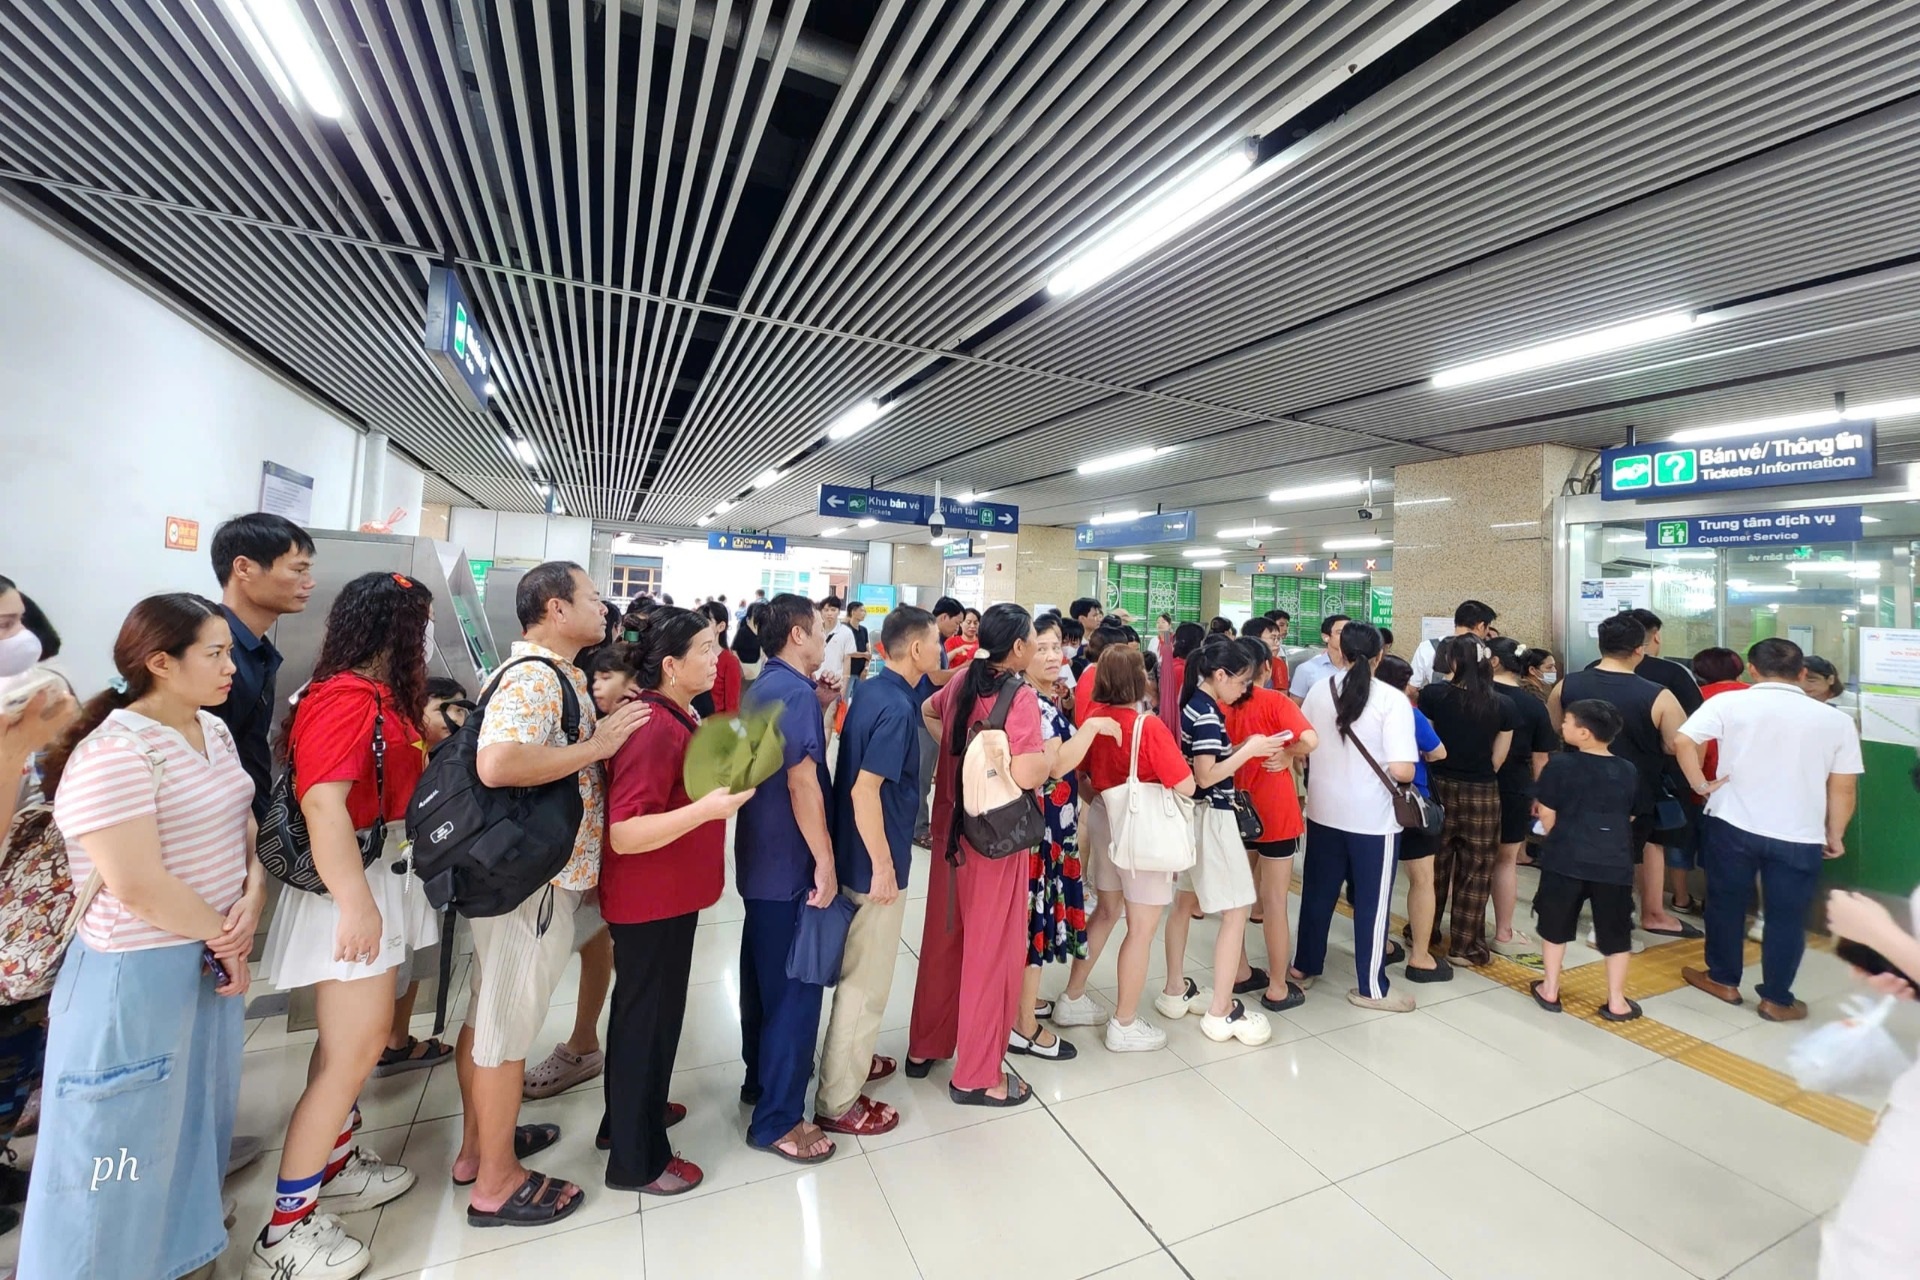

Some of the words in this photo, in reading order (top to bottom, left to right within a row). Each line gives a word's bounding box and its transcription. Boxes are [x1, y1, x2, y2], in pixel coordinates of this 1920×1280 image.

[1700, 447, 1737, 465] Bán
[1772, 437, 1835, 456] Thông
[1701, 465, 1752, 480] Tickets
[1762, 455, 1855, 475] Information
[869, 496, 888, 507] Khu
[890, 498, 907, 509] bán
[910, 501, 920, 510] vé
[869, 508, 891, 516] Tickets
[950, 504, 963, 514] lên
[965, 506, 978, 516] tàu
[1698, 520, 1740, 531] Trung
[1743, 516, 1772, 528] tâm
[1775, 514, 1810, 529] dịch
[1814, 514, 1835, 527] vụ
[1698, 534, 1751, 544] Customer
[1753, 532, 1799, 542] Service
[765, 540, 773, 550] A
